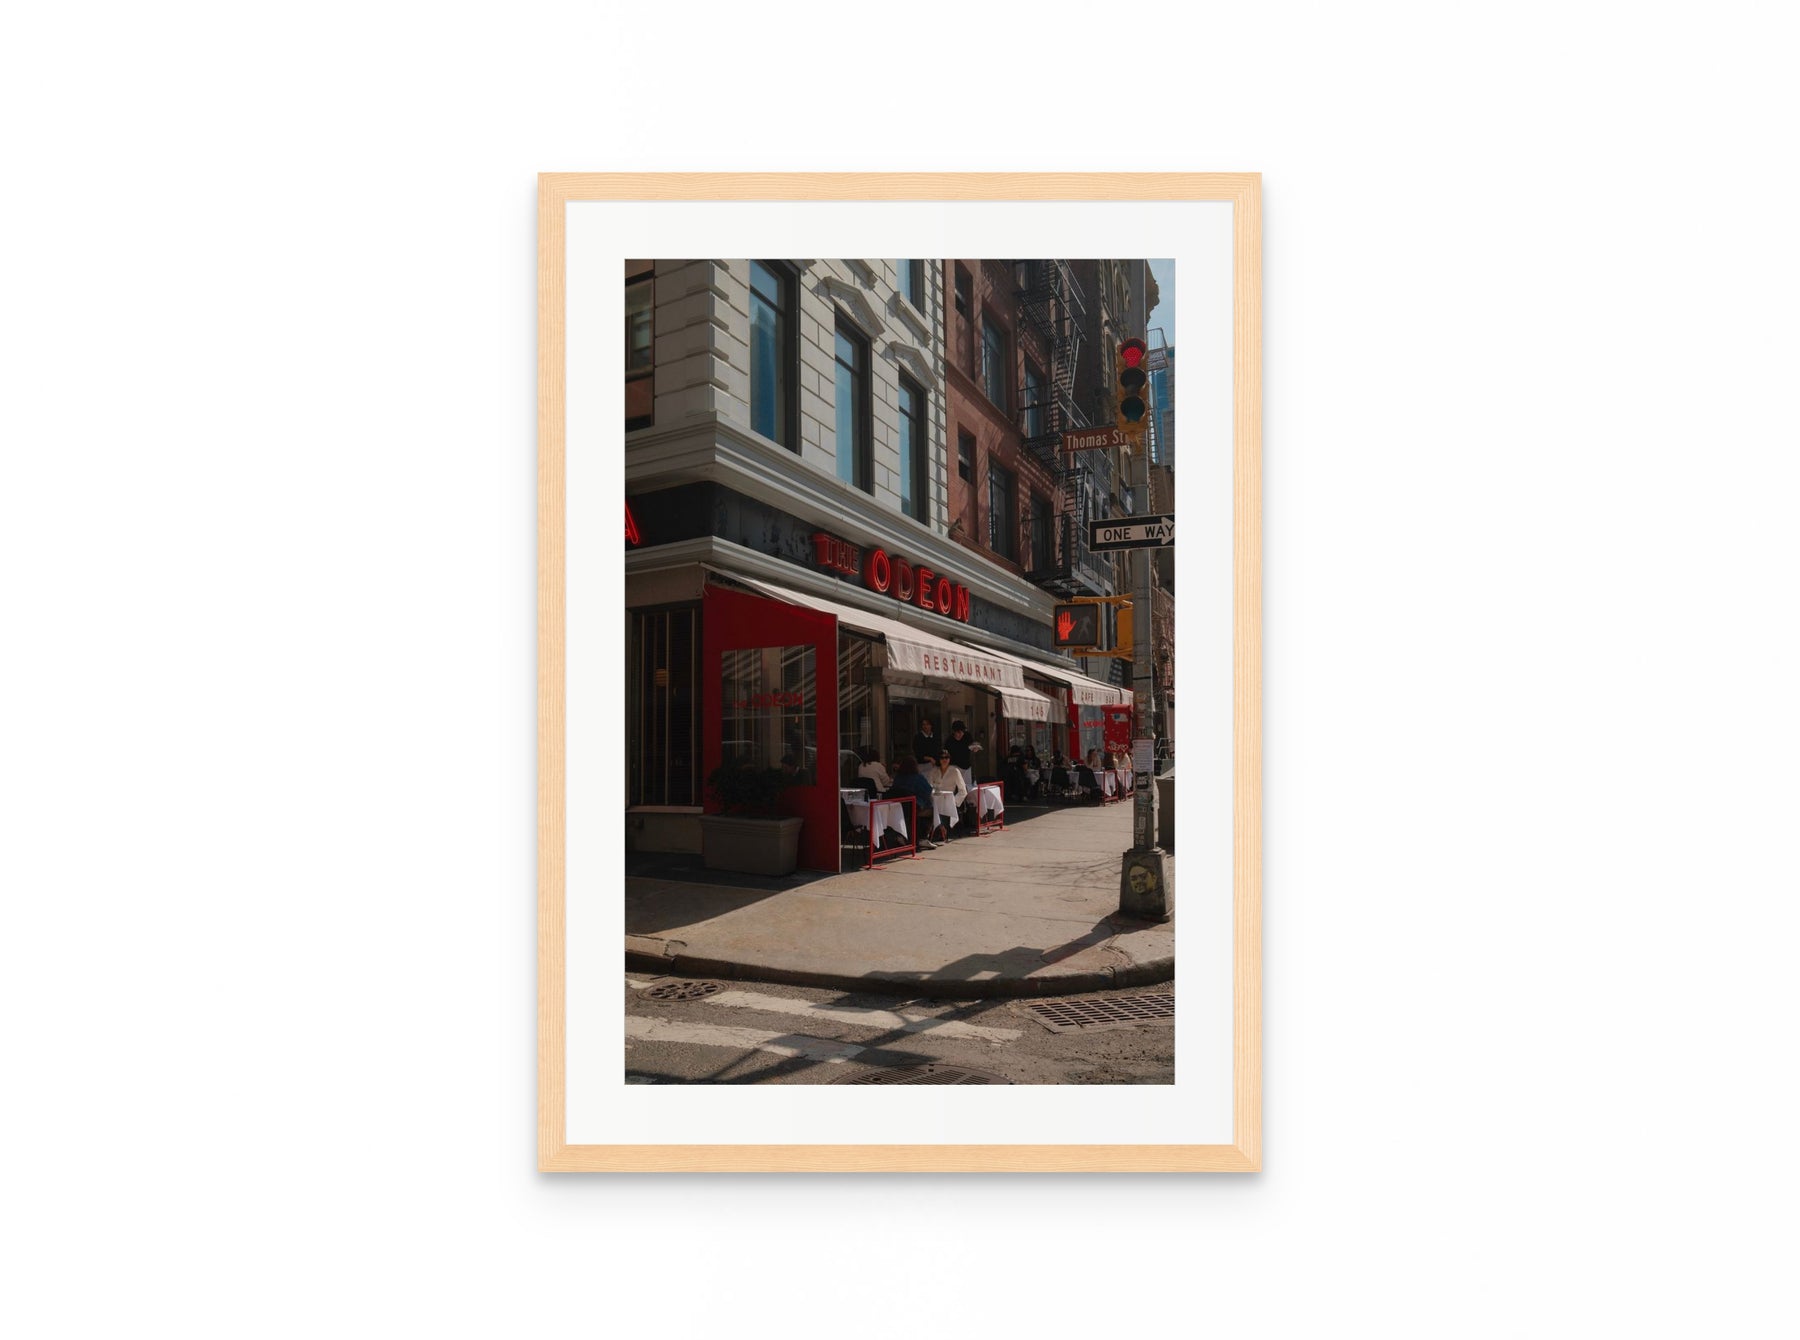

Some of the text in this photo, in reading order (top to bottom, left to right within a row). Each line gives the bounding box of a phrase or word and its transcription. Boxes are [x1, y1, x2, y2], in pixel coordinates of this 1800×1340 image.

[1066, 434, 1108, 450] Thomas
[1103, 524, 1174, 542] ONE WAY
[817, 533, 971, 624] THE ODEON
[923, 654, 1002, 682] RESTAURANT
